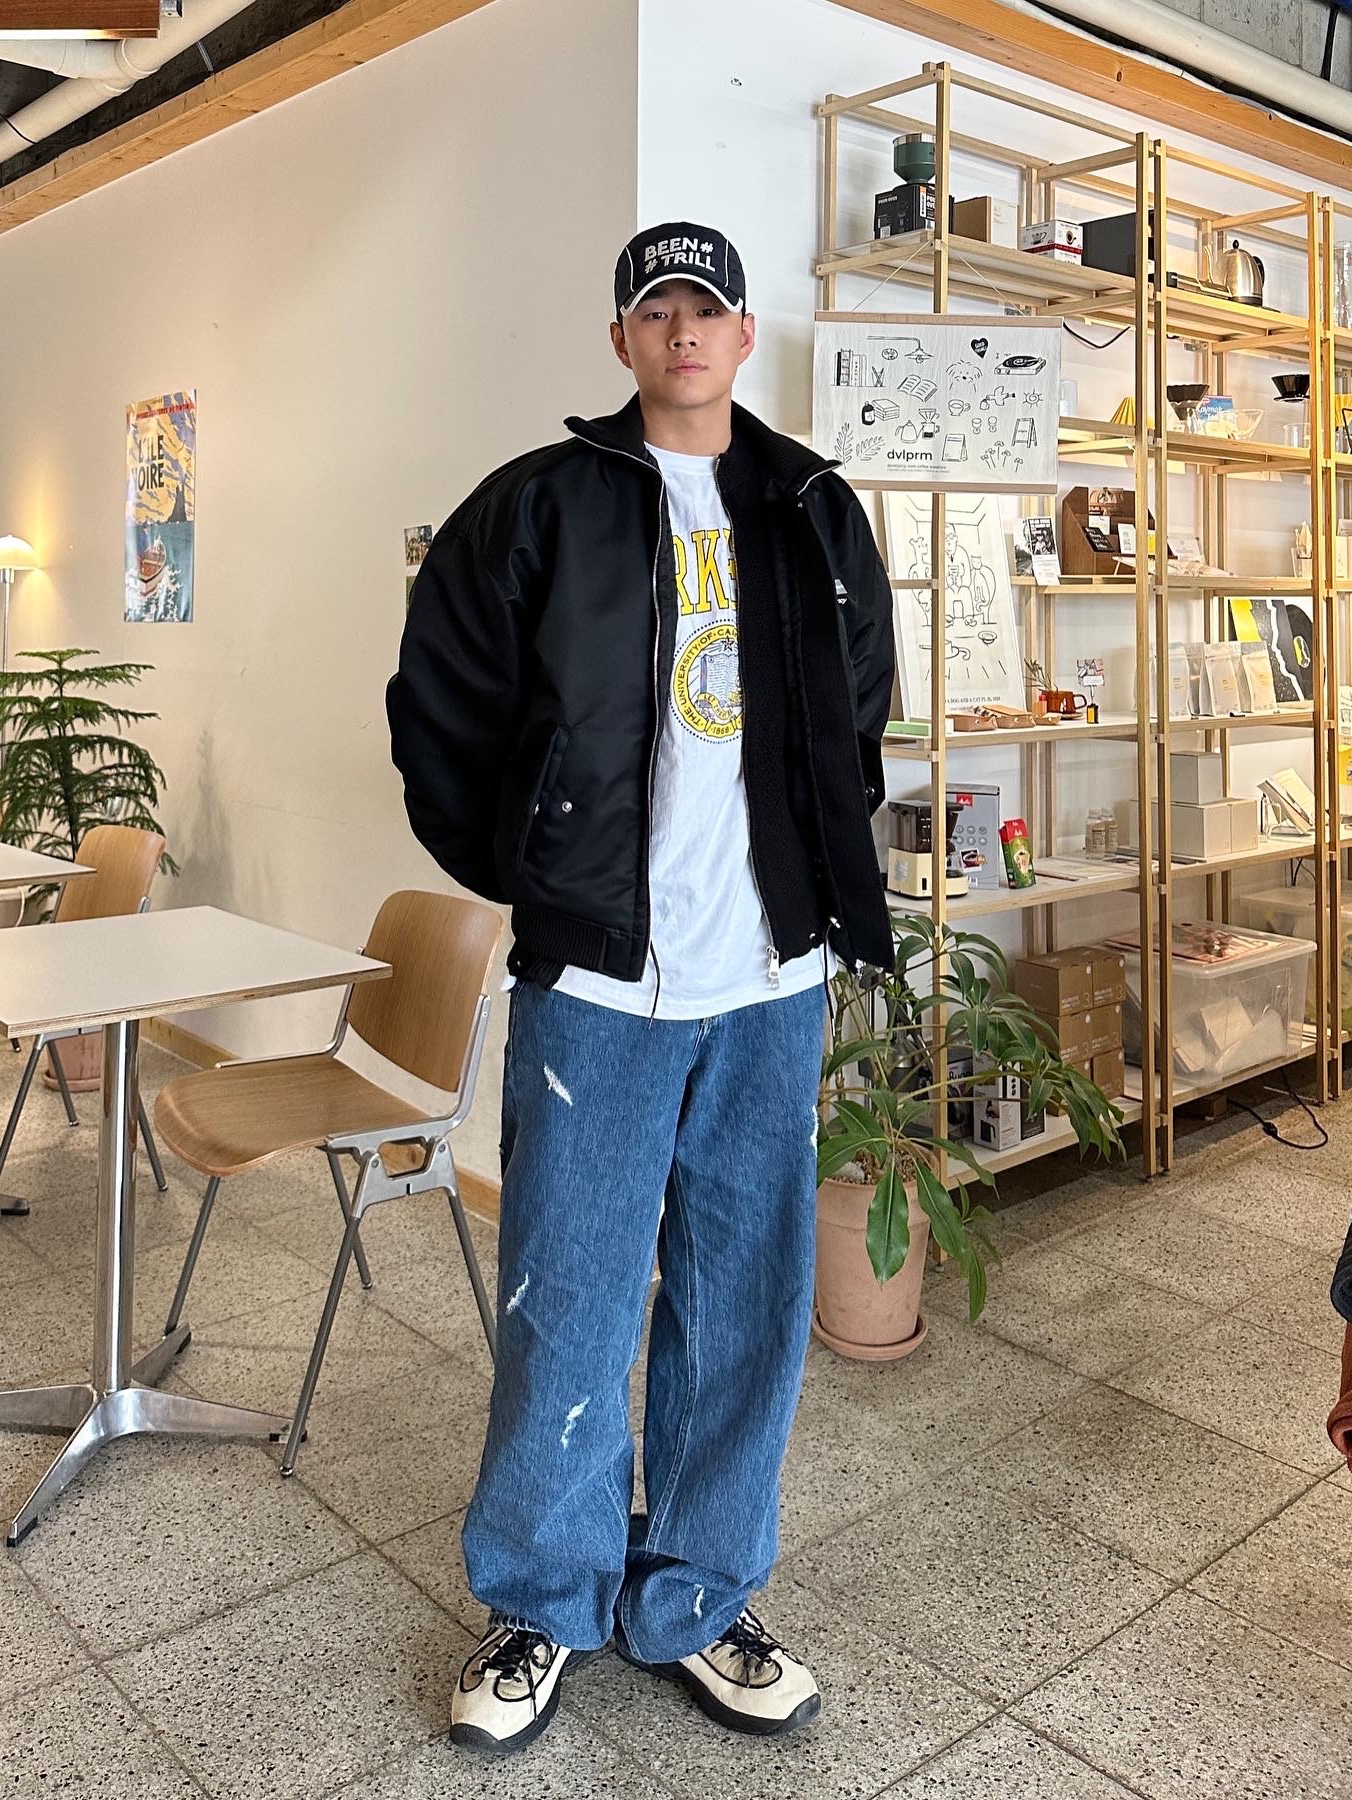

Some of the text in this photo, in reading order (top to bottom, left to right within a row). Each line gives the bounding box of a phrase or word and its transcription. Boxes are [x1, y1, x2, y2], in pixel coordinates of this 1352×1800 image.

[886, 448, 933, 463] dvlprm
[676, 628, 738, 727] THE UNIVERSITY OF CAL
[712, 726, 730, 735] 1868
